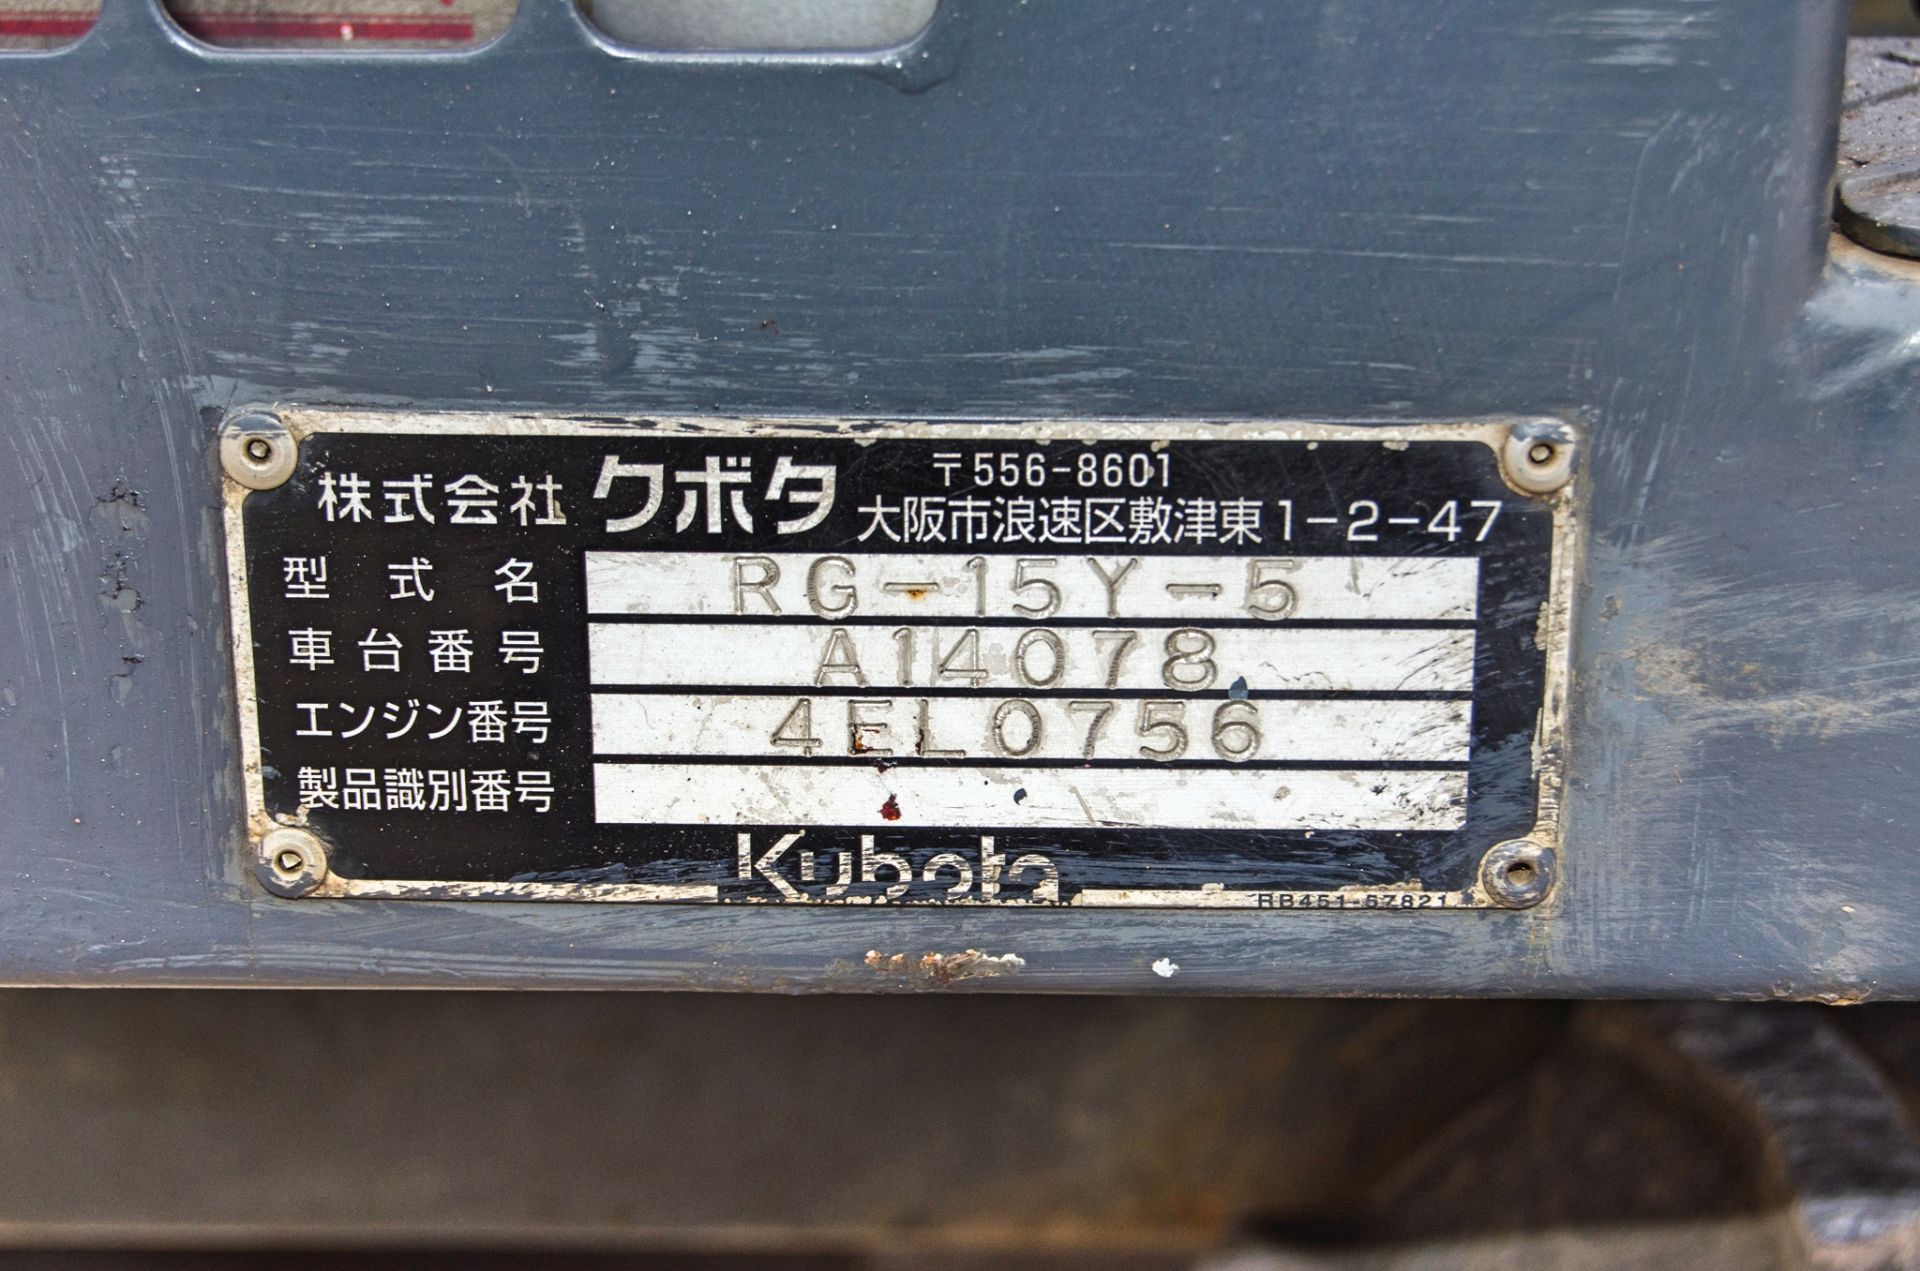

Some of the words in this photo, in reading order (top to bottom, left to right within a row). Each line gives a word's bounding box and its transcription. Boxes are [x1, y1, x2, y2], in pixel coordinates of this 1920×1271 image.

[592, 454, 837, 536] クボタ
[734, 554, 1302, 619] RG-15Y-5
[288, 627, 544, 676] 車台番号
[815, 624, 1220, 693] A14078
[295, 699, 551, 743] エンジン番号
[770, 697, 1262, 761] 4EL0756
[297, 767, 555, 814] 製品識別番号
[737, 830, 1060, 902] Kubota
[1256, 891, 1448, 910] RB451-57821
